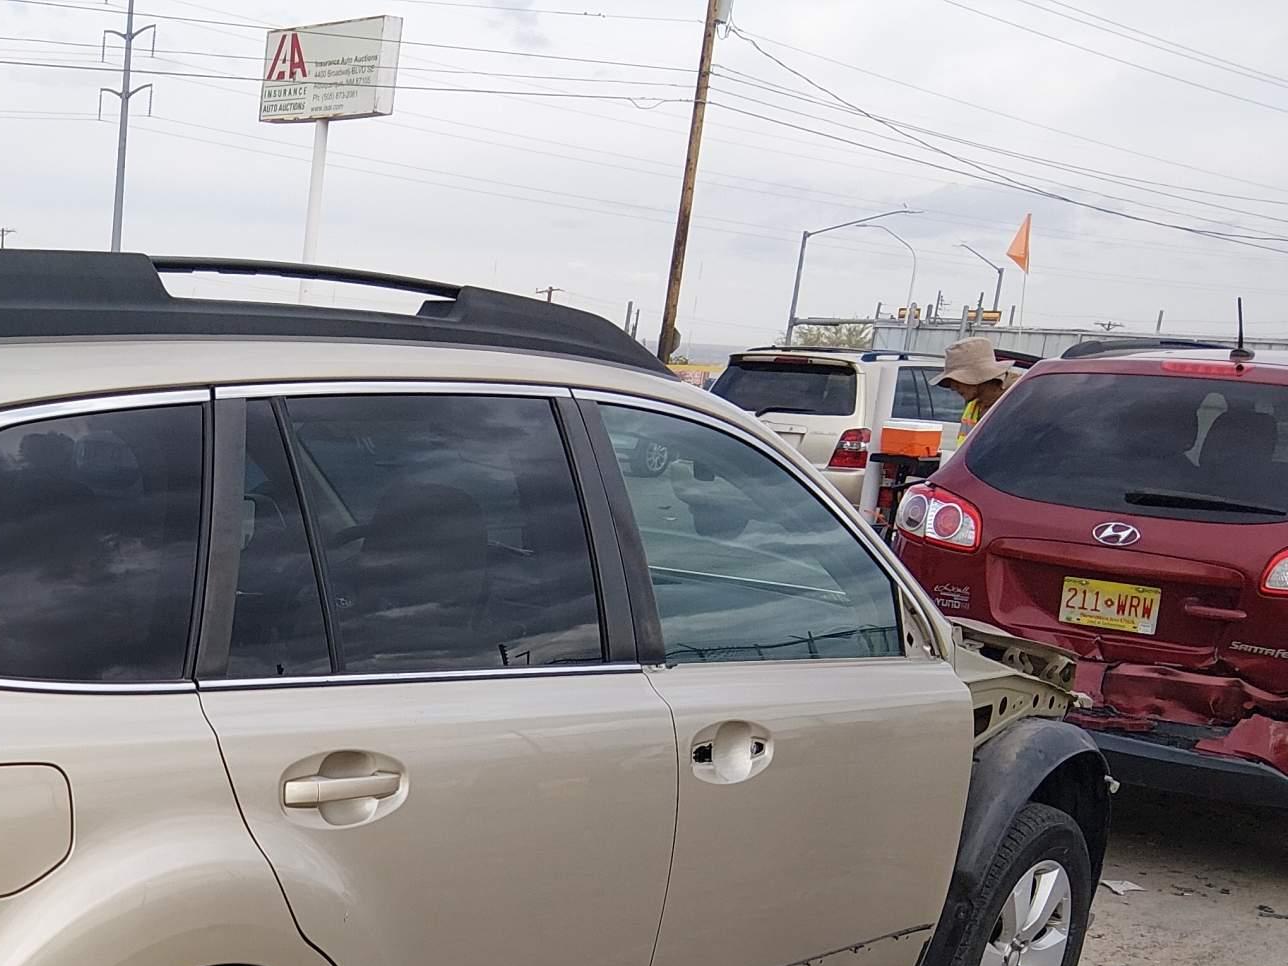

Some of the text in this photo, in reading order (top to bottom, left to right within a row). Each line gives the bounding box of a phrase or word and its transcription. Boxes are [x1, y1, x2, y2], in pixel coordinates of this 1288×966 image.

[354, 54, 378, 63] Auctions
[264, 86, 308, 99] INSURANCE
[262, 102, 305, 113] AUTO AUCTIONS
[1065, 587, 1101, 613] 211
[1116, 593, 1155, 620] WRW
